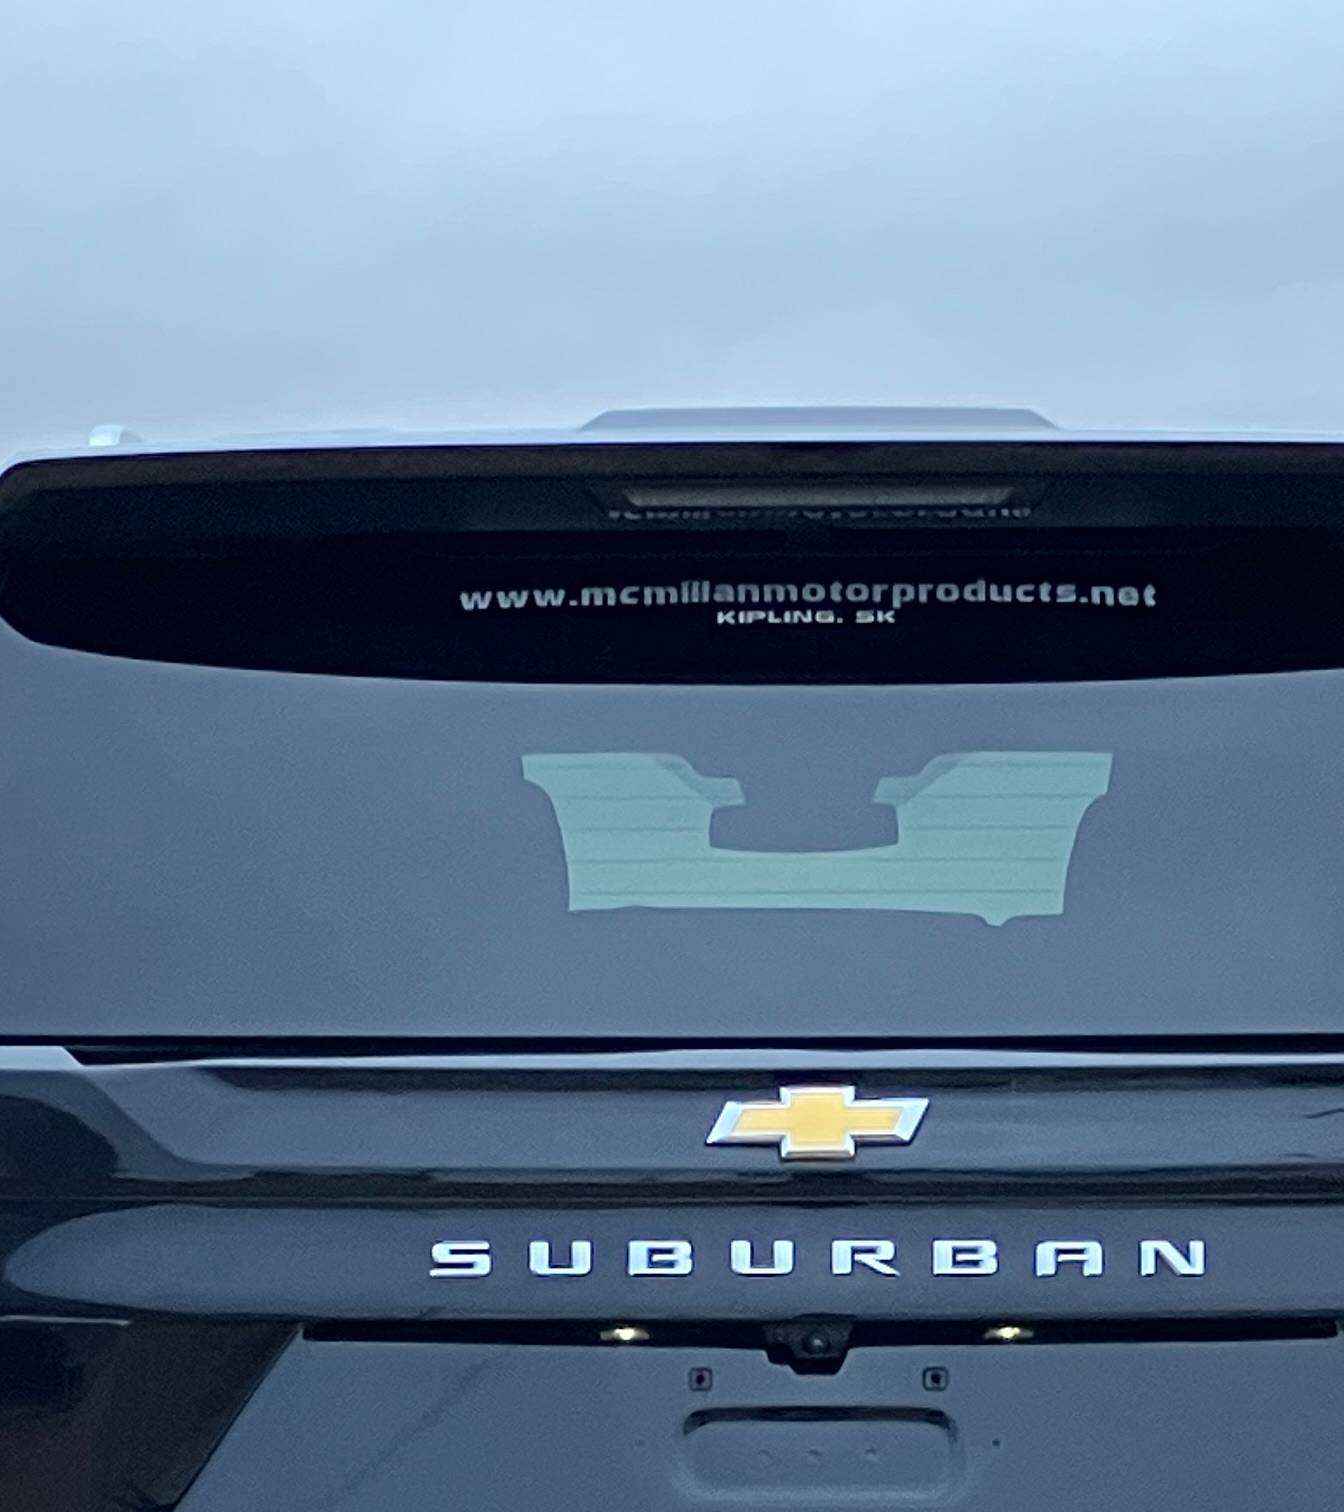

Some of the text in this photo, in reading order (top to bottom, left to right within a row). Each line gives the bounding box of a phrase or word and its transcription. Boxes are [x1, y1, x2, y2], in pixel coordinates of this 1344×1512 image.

[459, 580, 1156, 609] www.mcmillanmotorproducts.net
[855, 609, 896, 624] SK
[429, 1239, 1207, 1277] SUBURBAN
